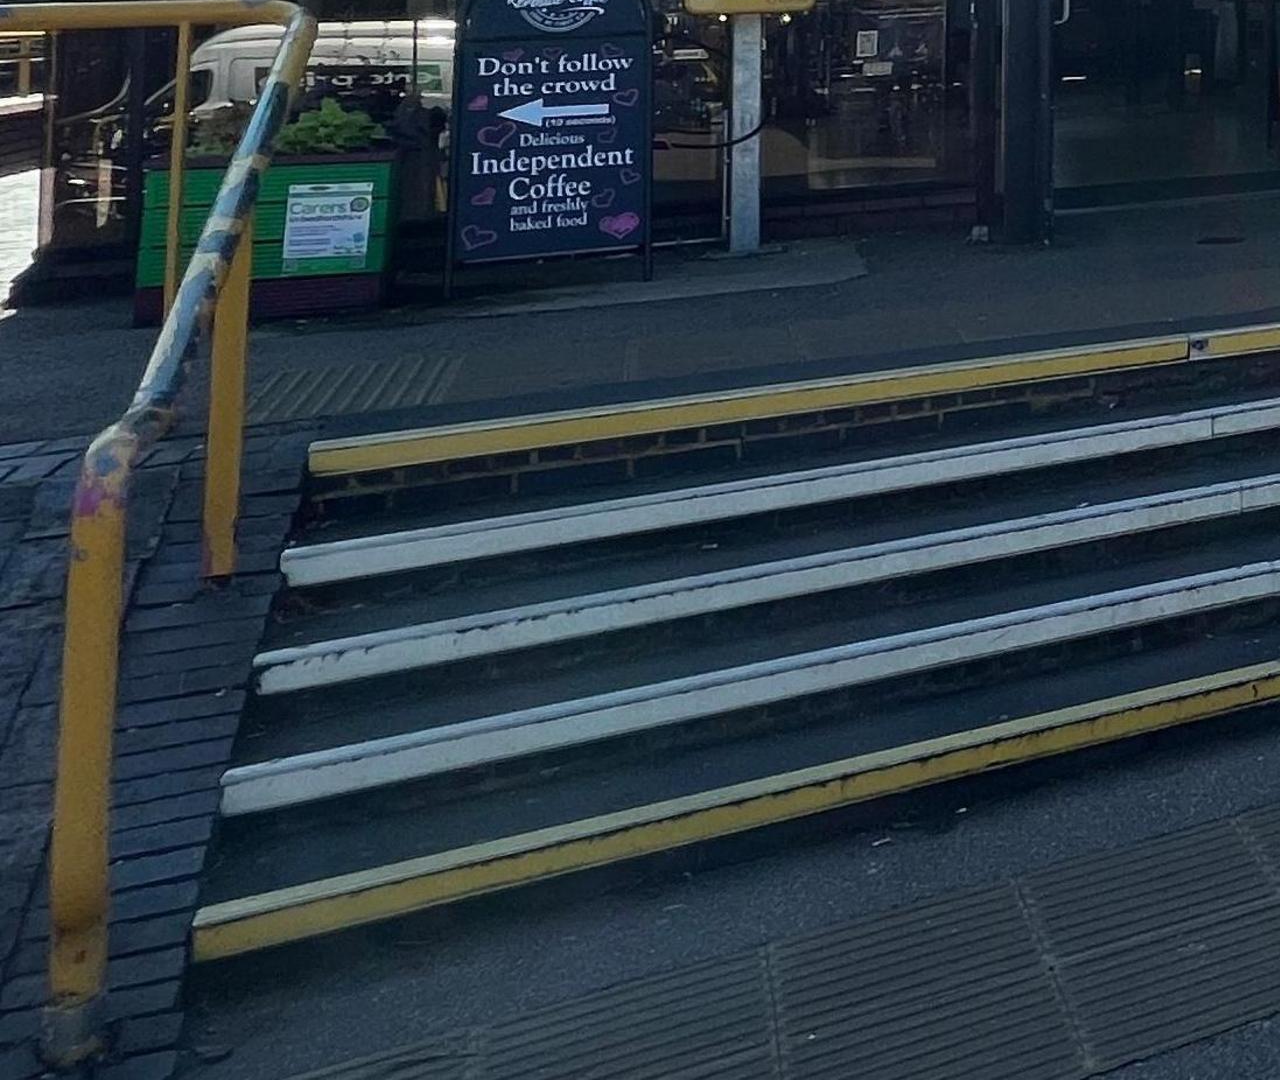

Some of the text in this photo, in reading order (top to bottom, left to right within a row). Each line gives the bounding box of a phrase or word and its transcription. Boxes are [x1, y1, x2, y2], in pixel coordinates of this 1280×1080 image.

[477, 53, 634, 76] Don't follow
[493, 72, 617, 97] the crowd
[519, 132, 586, 147] Delicious
[471, 144, 634, 176] Independent
[508, 173, 592, 201] Coffee
[510, 197, 590, 216] and freshly
[509, 212, 588, 232] baked food
